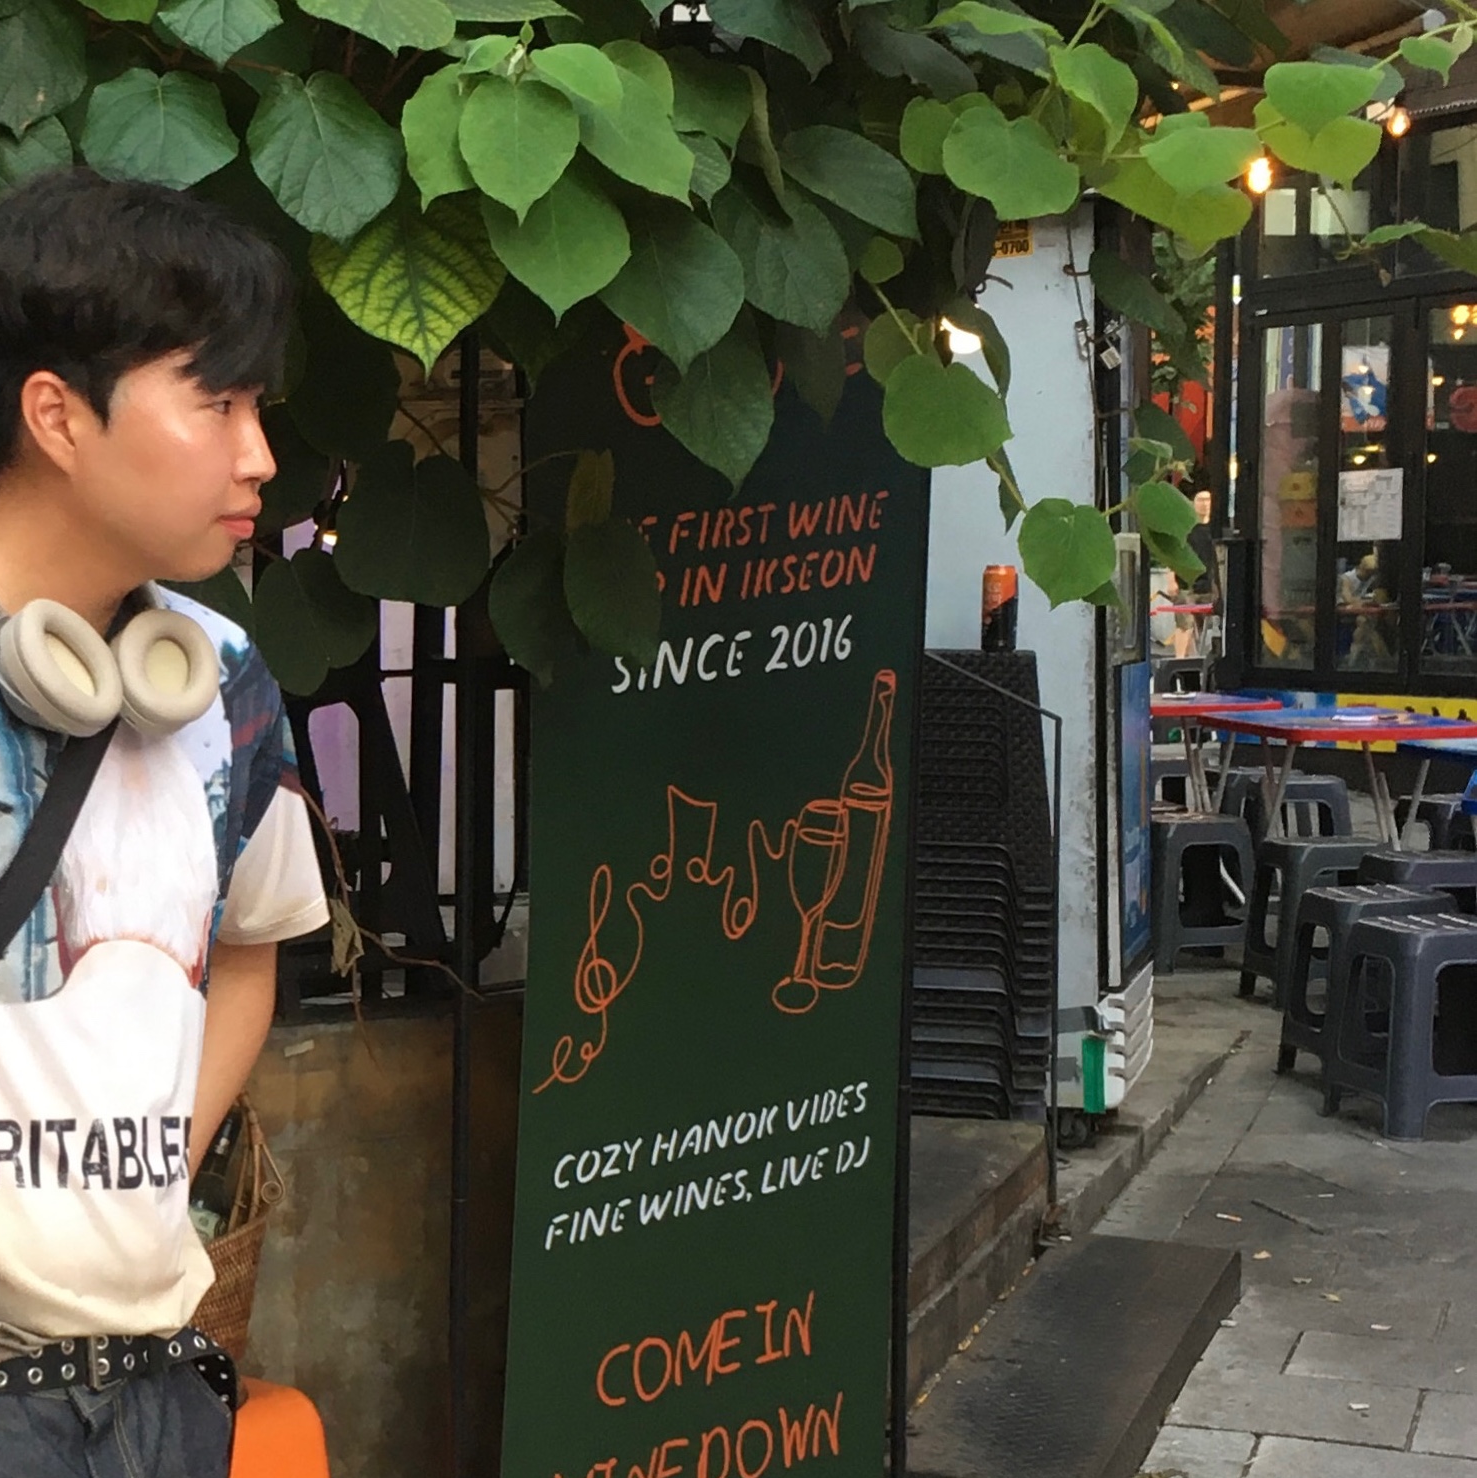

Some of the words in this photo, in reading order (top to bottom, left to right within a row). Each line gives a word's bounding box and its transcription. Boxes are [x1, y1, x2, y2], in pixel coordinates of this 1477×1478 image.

[669, 502, 777, 554] FIRST
[788, 490, 890, 540] WINE
[679, 562, 727, 607] IN
[740, 543, 877, 600] IKSEON
[764, 613, 853, 673] 2016
[554, 1137, 643, 1189] COZY
[651, 1105, 779, 1167] HANOK
[786, 1081, 869, 1132] VIBES
[545, 1198, 632, 1251] FINE
[638, 1169, 754, 1226] WINES,
[760, 1147, 830, 1195] LIVE
[835, 1135, 871, 1175] DJ
[596, 1308, 748, 1407] COME
[754, 1289, 815, 1365] IN
